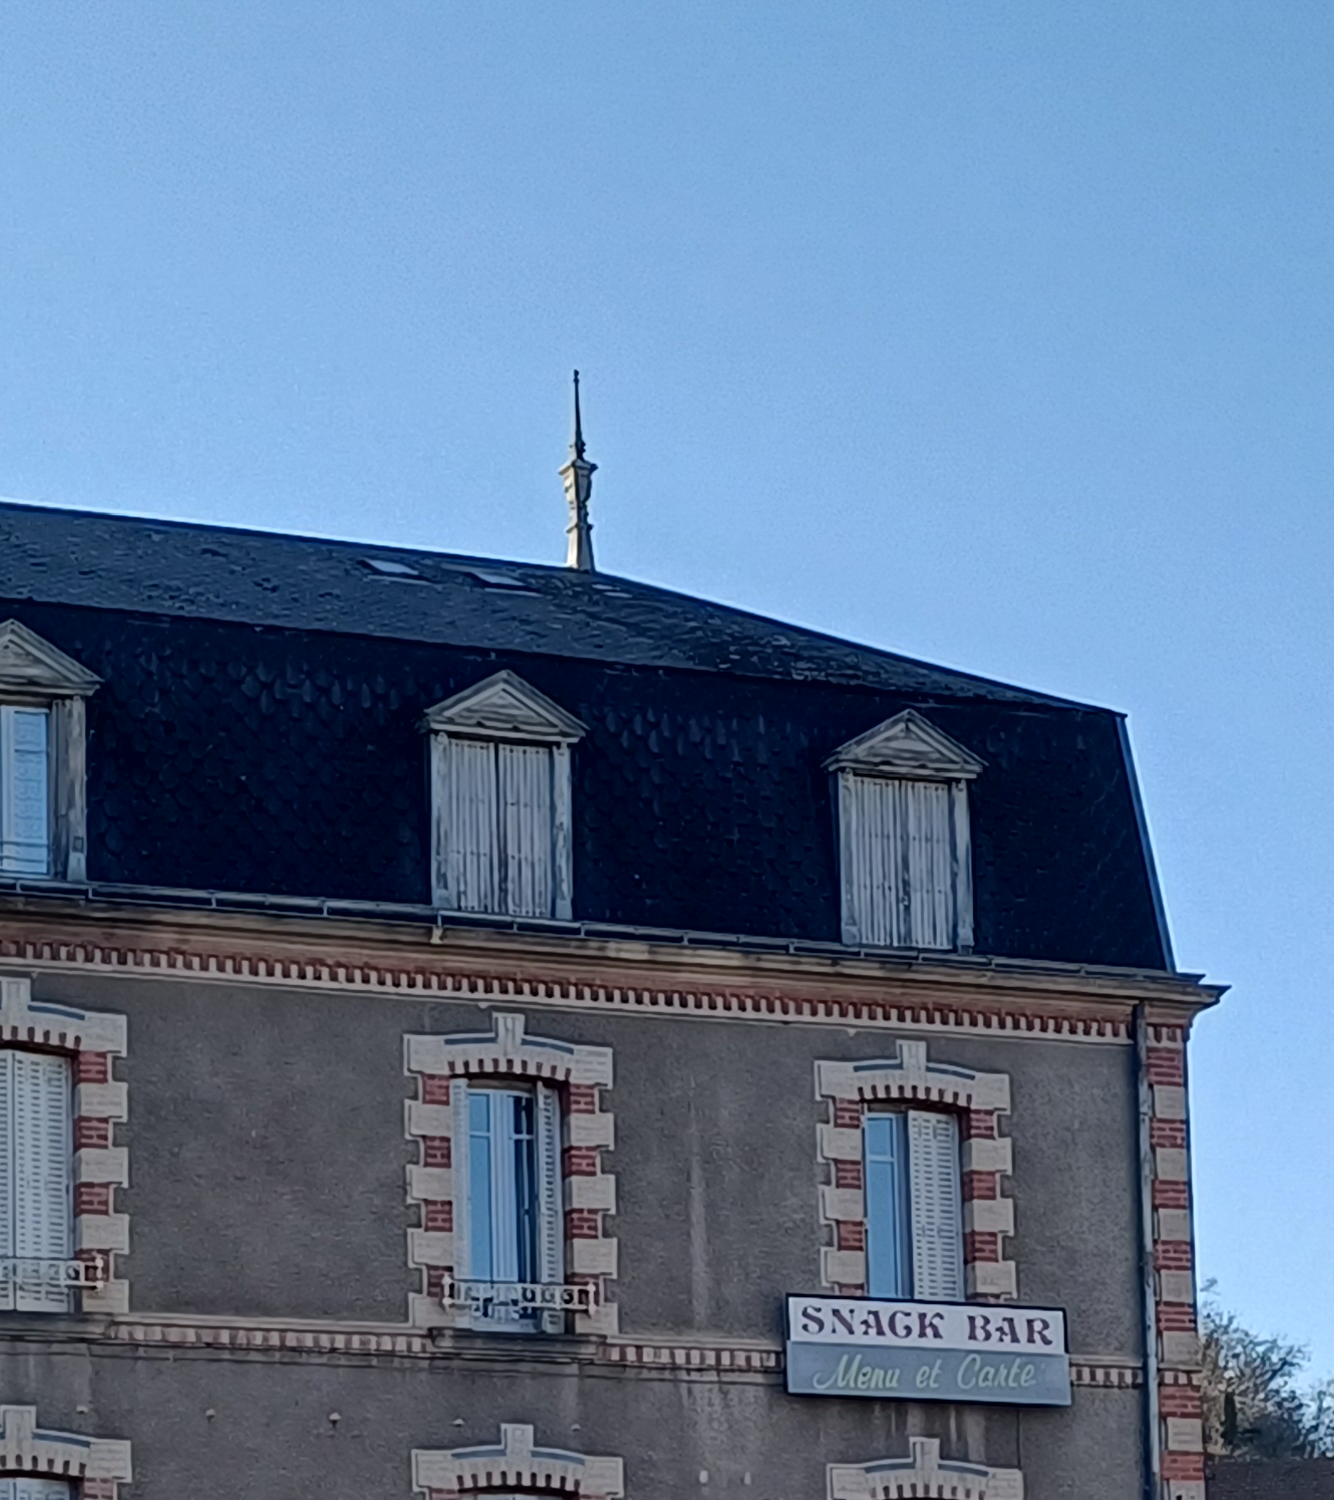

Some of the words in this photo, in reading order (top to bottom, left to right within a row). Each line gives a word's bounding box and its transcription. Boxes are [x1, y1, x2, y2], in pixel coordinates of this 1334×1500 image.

[801, 1305, 945, 1340] SNACK
[967, 1313, 1053, 1346] BAR
[814, 1354, 900, 1390] Menu
[917, 1360, 942, 1388] et
[957, 1353, 1037, 1390] Carte
